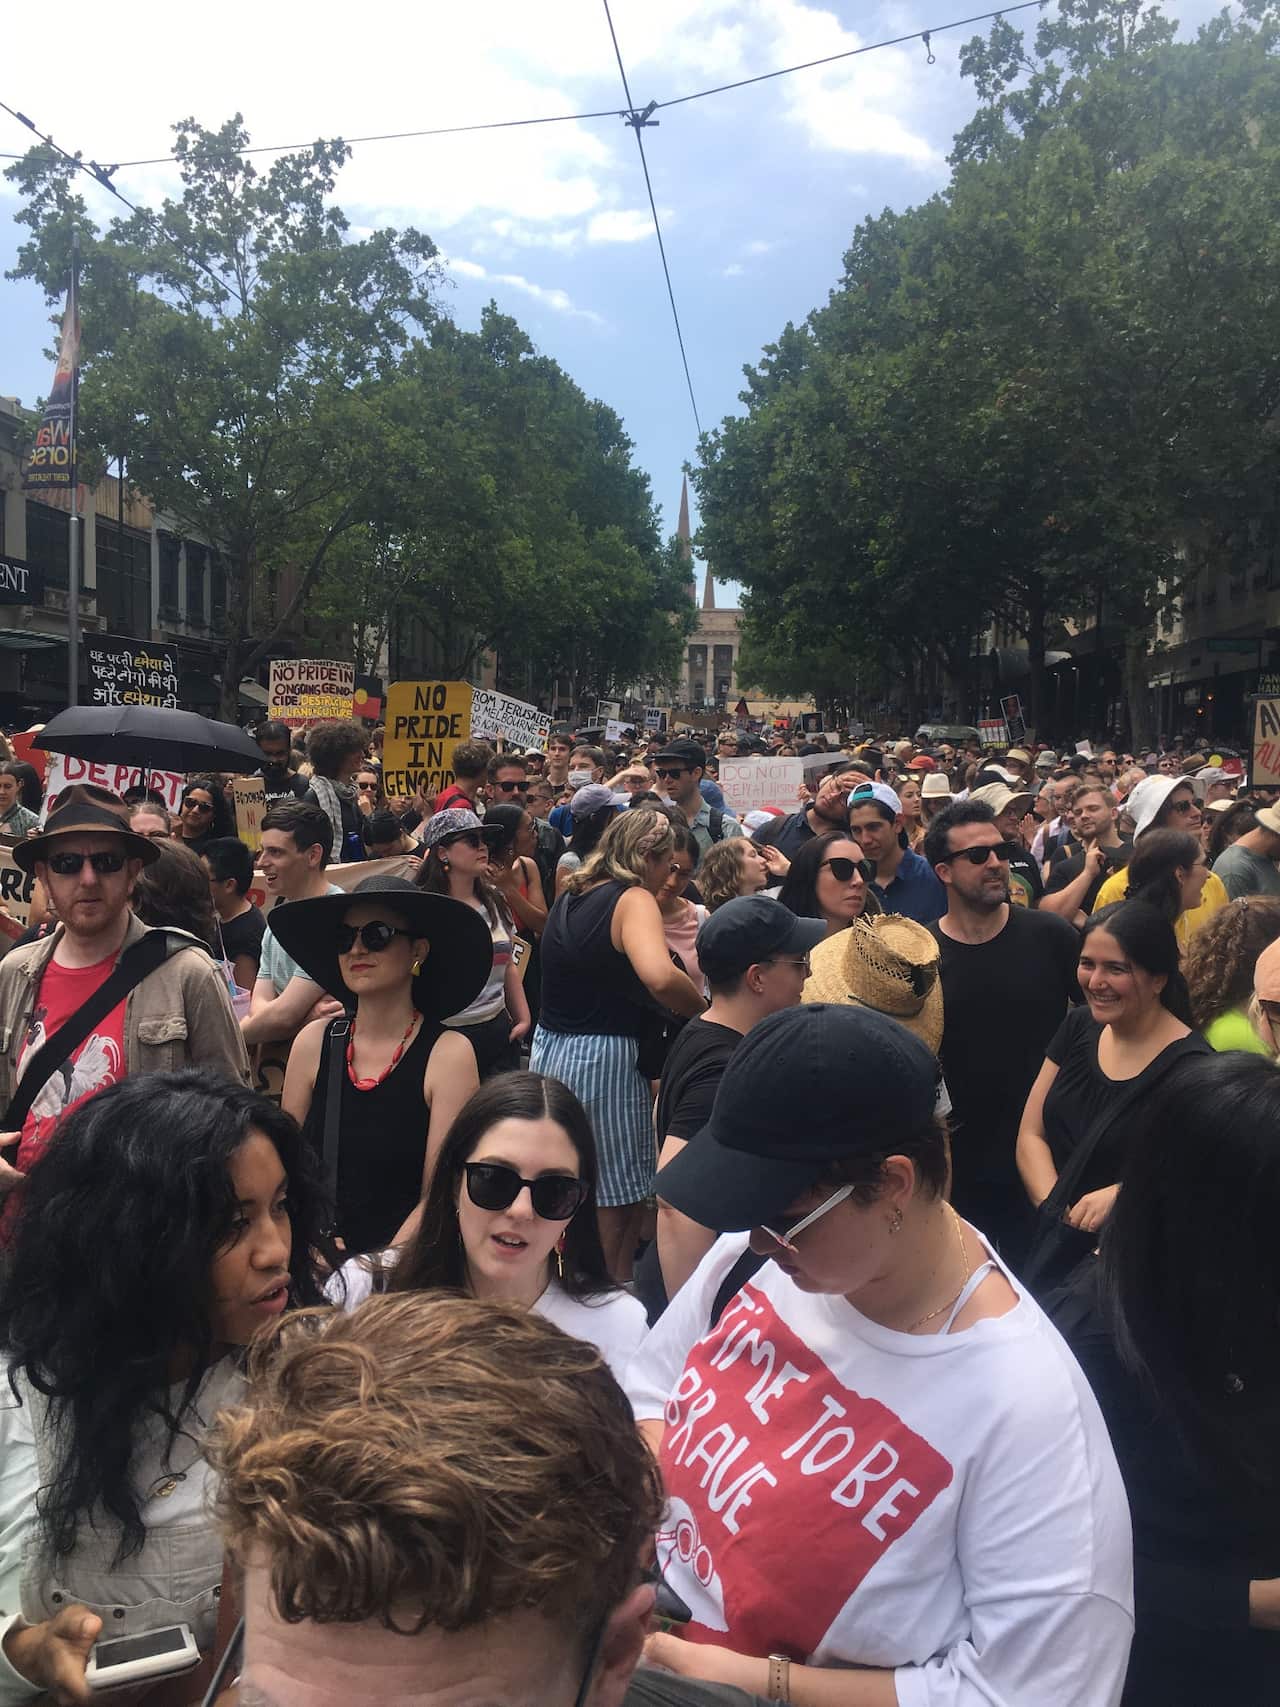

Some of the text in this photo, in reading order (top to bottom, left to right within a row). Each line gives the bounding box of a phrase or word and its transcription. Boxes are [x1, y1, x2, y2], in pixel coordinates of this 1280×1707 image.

[273, 666, 353, 683] NO PRIDE IN
[275, 683, 320, 695] ONGOING
[414, 684, 447, 711] NO
[270, 707, 283, 717] OF
[472, 690, 553, 728] ROM JERUSALEM
[482, 706, 538, 735] MELBOURNE
[394, 713, 463, 739] PRIDE
[407, 742, 443, 768] IN
[384, 770, 456, 796] GENOCID
[723, 764, 793, 781] DO NOT
[665, 1366, 777, 1536] BRAVE
[781, 1394, 920, 1541] TO BE
